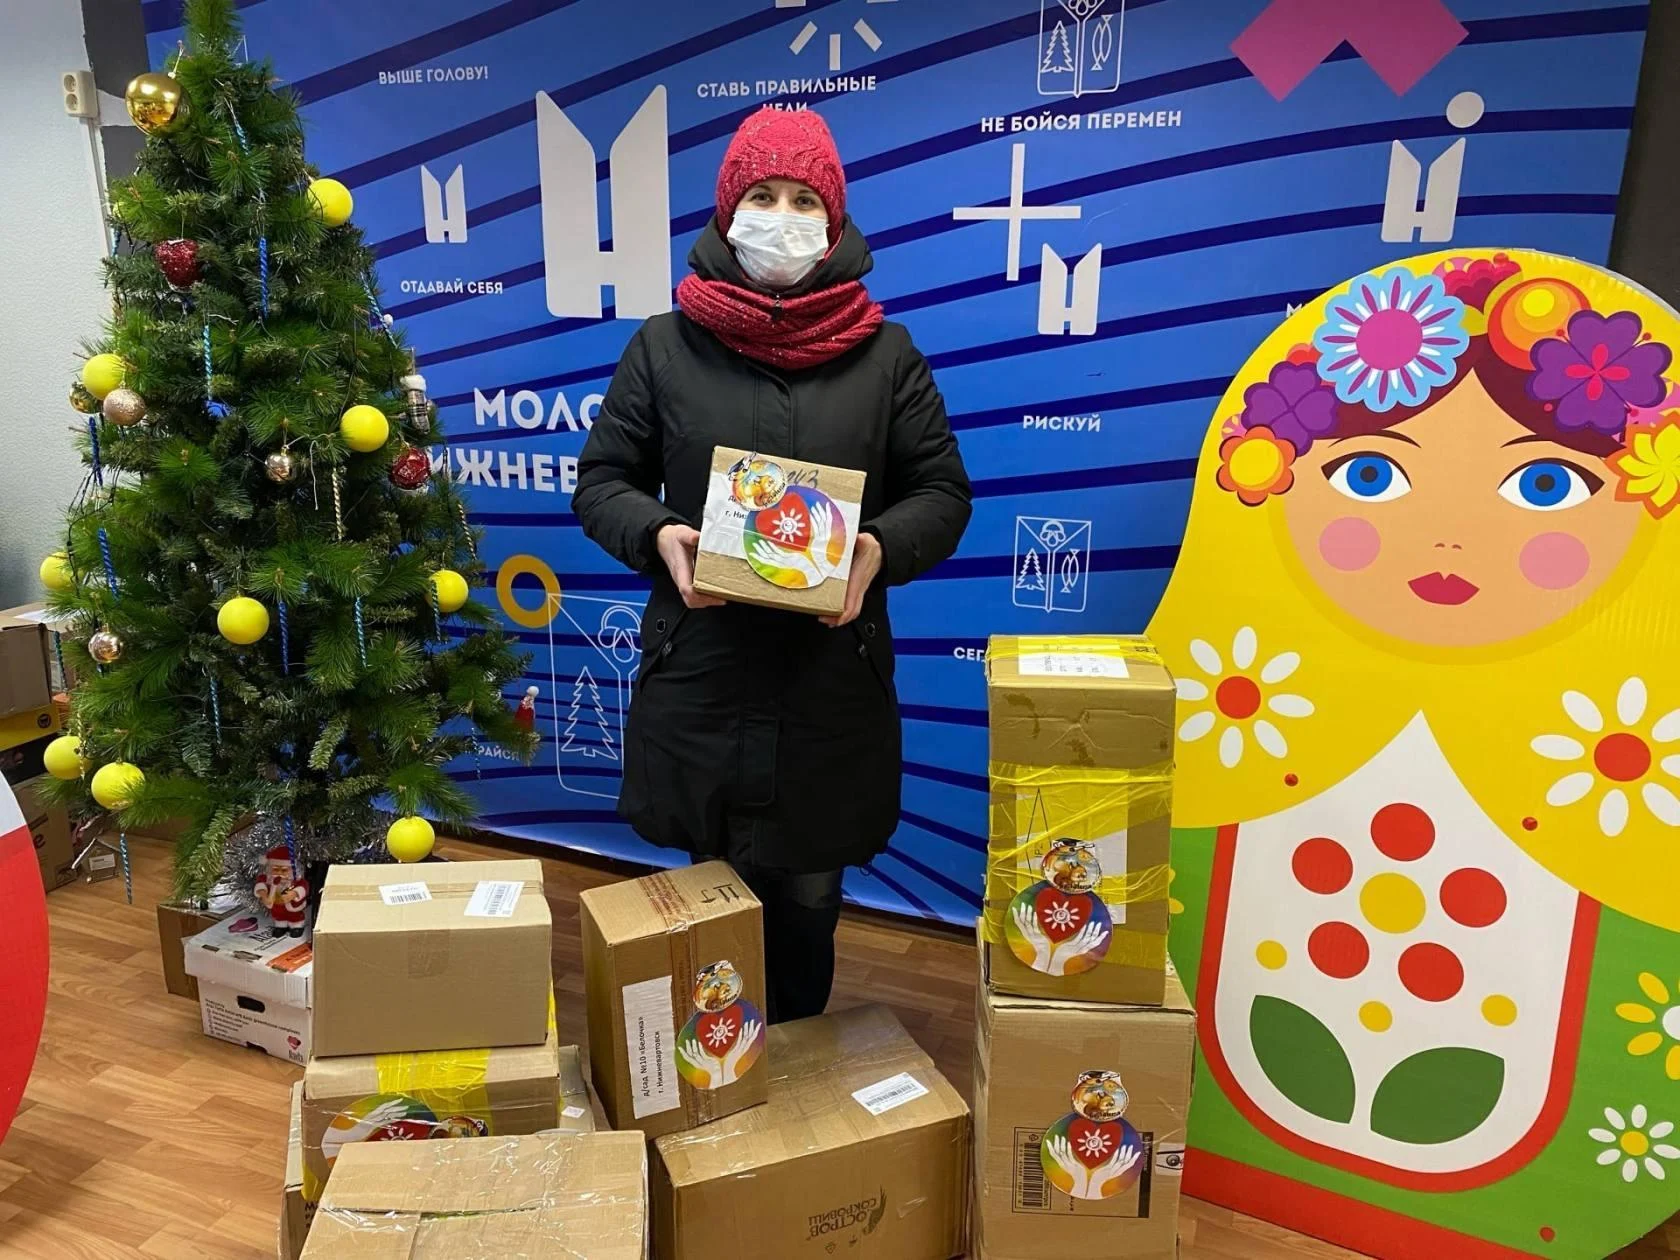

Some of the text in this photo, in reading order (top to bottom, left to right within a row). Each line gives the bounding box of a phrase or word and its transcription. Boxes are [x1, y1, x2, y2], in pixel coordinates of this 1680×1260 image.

[378, 65, 489, 85] ВЫШЕ ГОЛОВУ!
[697, 75, 877, 98] СТАВЬ ПРАВИЛЬНЫЕ
[980, 110, 1182, 132] НЕ БОЙСЯ ПЕРЕМЕН
[400, 277, 503, 294] ОТДАВАЙ СЕБЯ
[473, 387, 606, 433] МОЛО
[1022, 413, 1101, 432] РИСКУЙ
[425, 445, 579, 494] ИЖНЕВ
[953, 646, 986, 663] СЕГ
